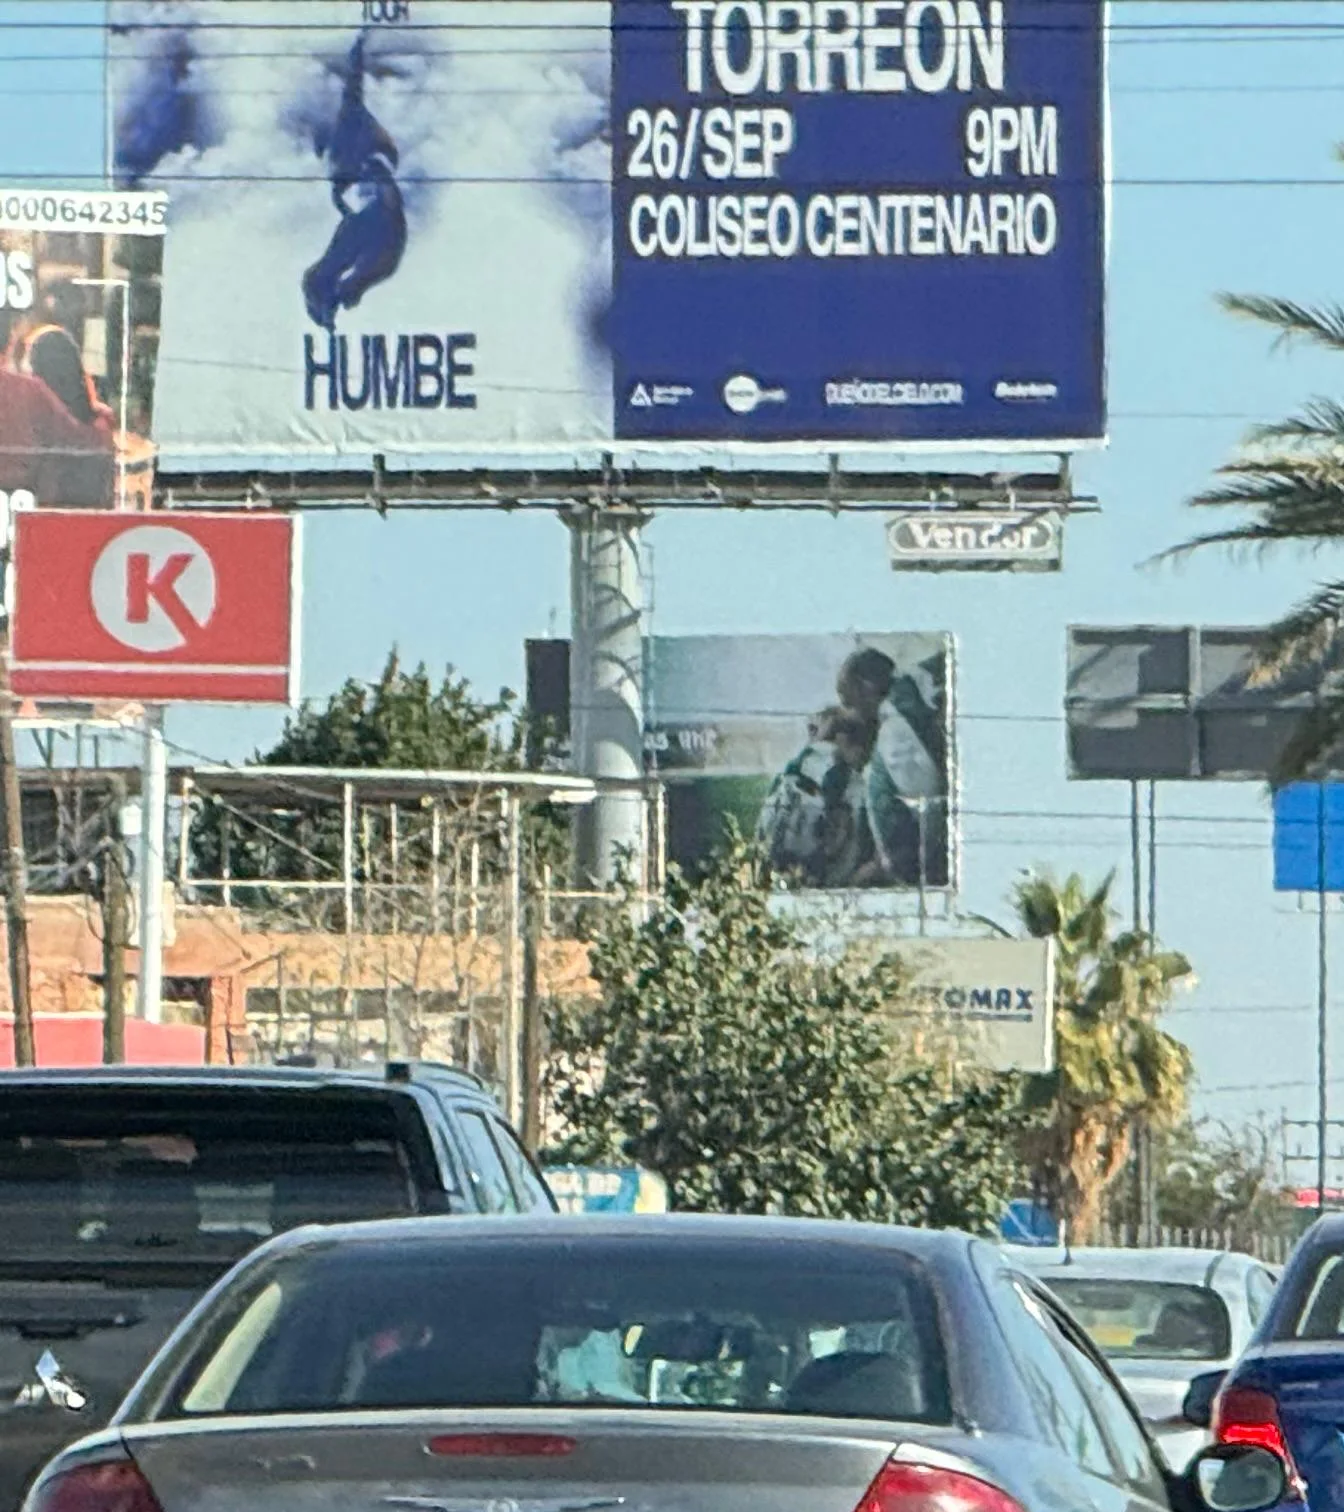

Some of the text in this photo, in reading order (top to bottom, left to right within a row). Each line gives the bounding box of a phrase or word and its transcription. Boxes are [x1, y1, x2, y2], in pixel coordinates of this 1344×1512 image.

[627, 106, 1058, 180] 26/SEP 9PM
[0, 196, 168, 226] 000642345
[629, 192, 1057, 257] COLISEO CENTENARIO
[303, 333, 477, 410] HUMBE
[125, 552, 208, 648] K
